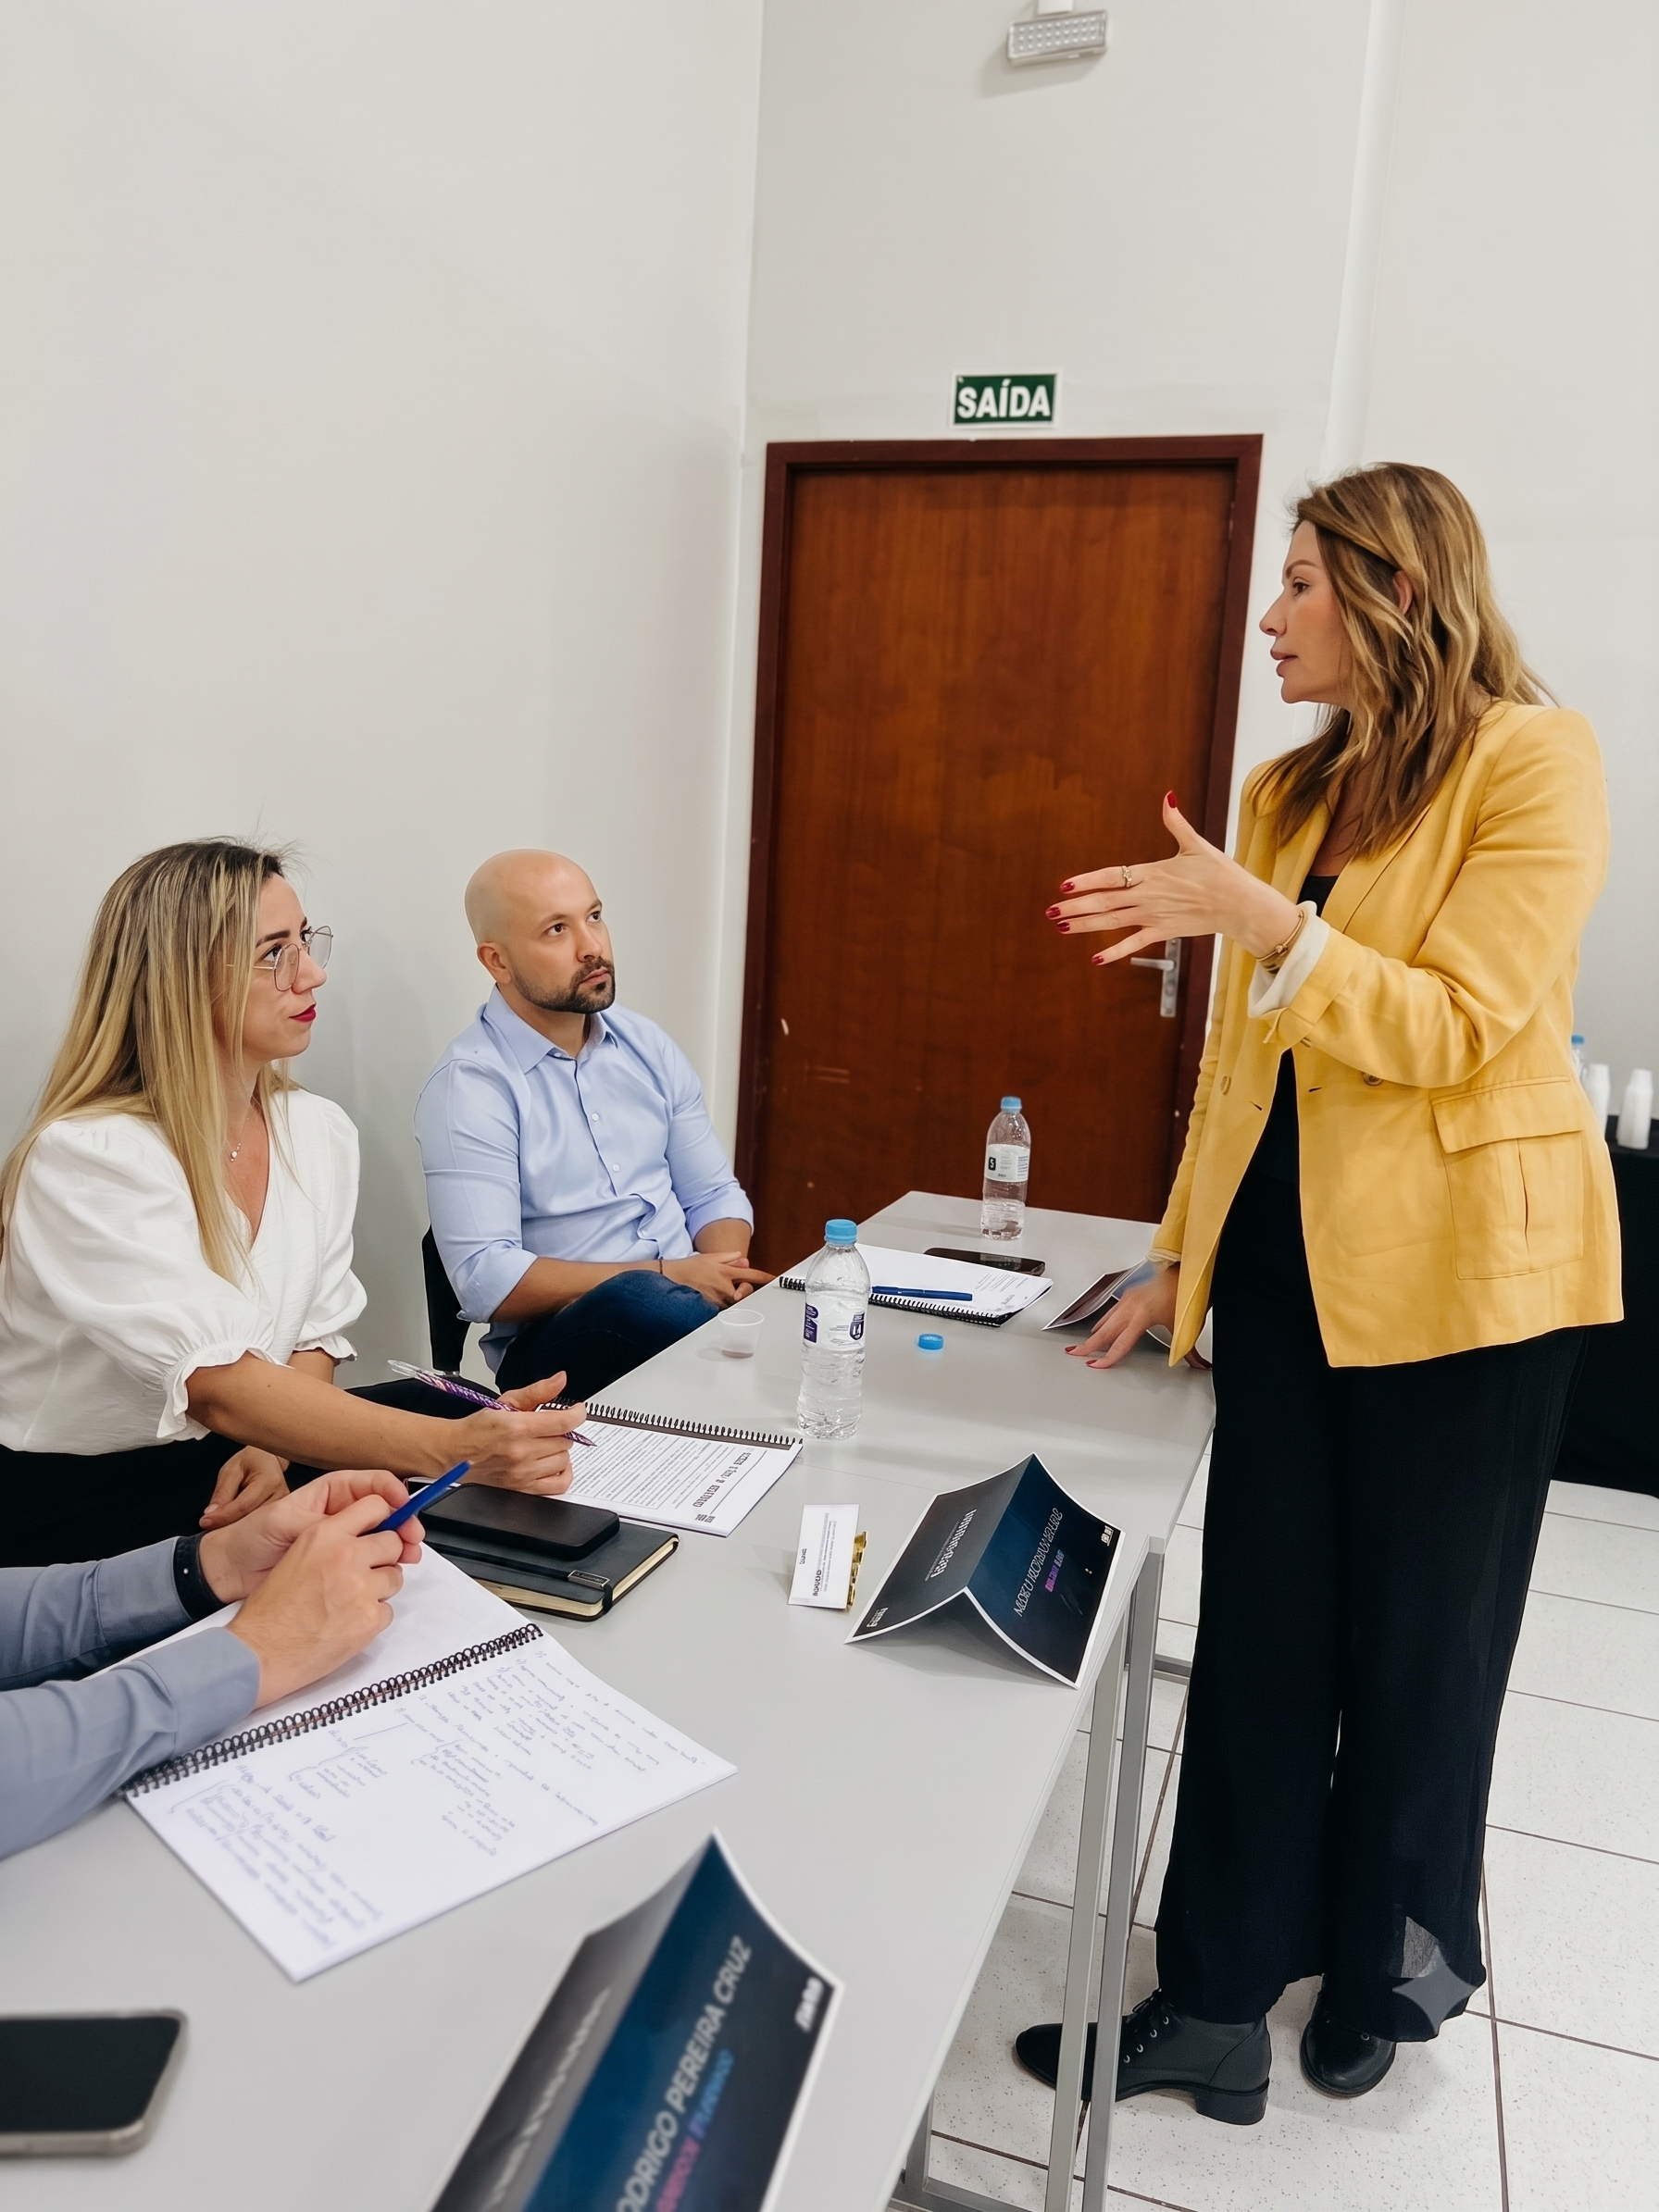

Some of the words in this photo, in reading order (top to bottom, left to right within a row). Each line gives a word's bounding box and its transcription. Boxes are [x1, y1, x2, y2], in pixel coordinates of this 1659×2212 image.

[957, 378, 1051, 418] SAÍDA
[665, 2002, 728, 2114] PEREIRA
[713, 1933, 753, 2006] CRUZ
